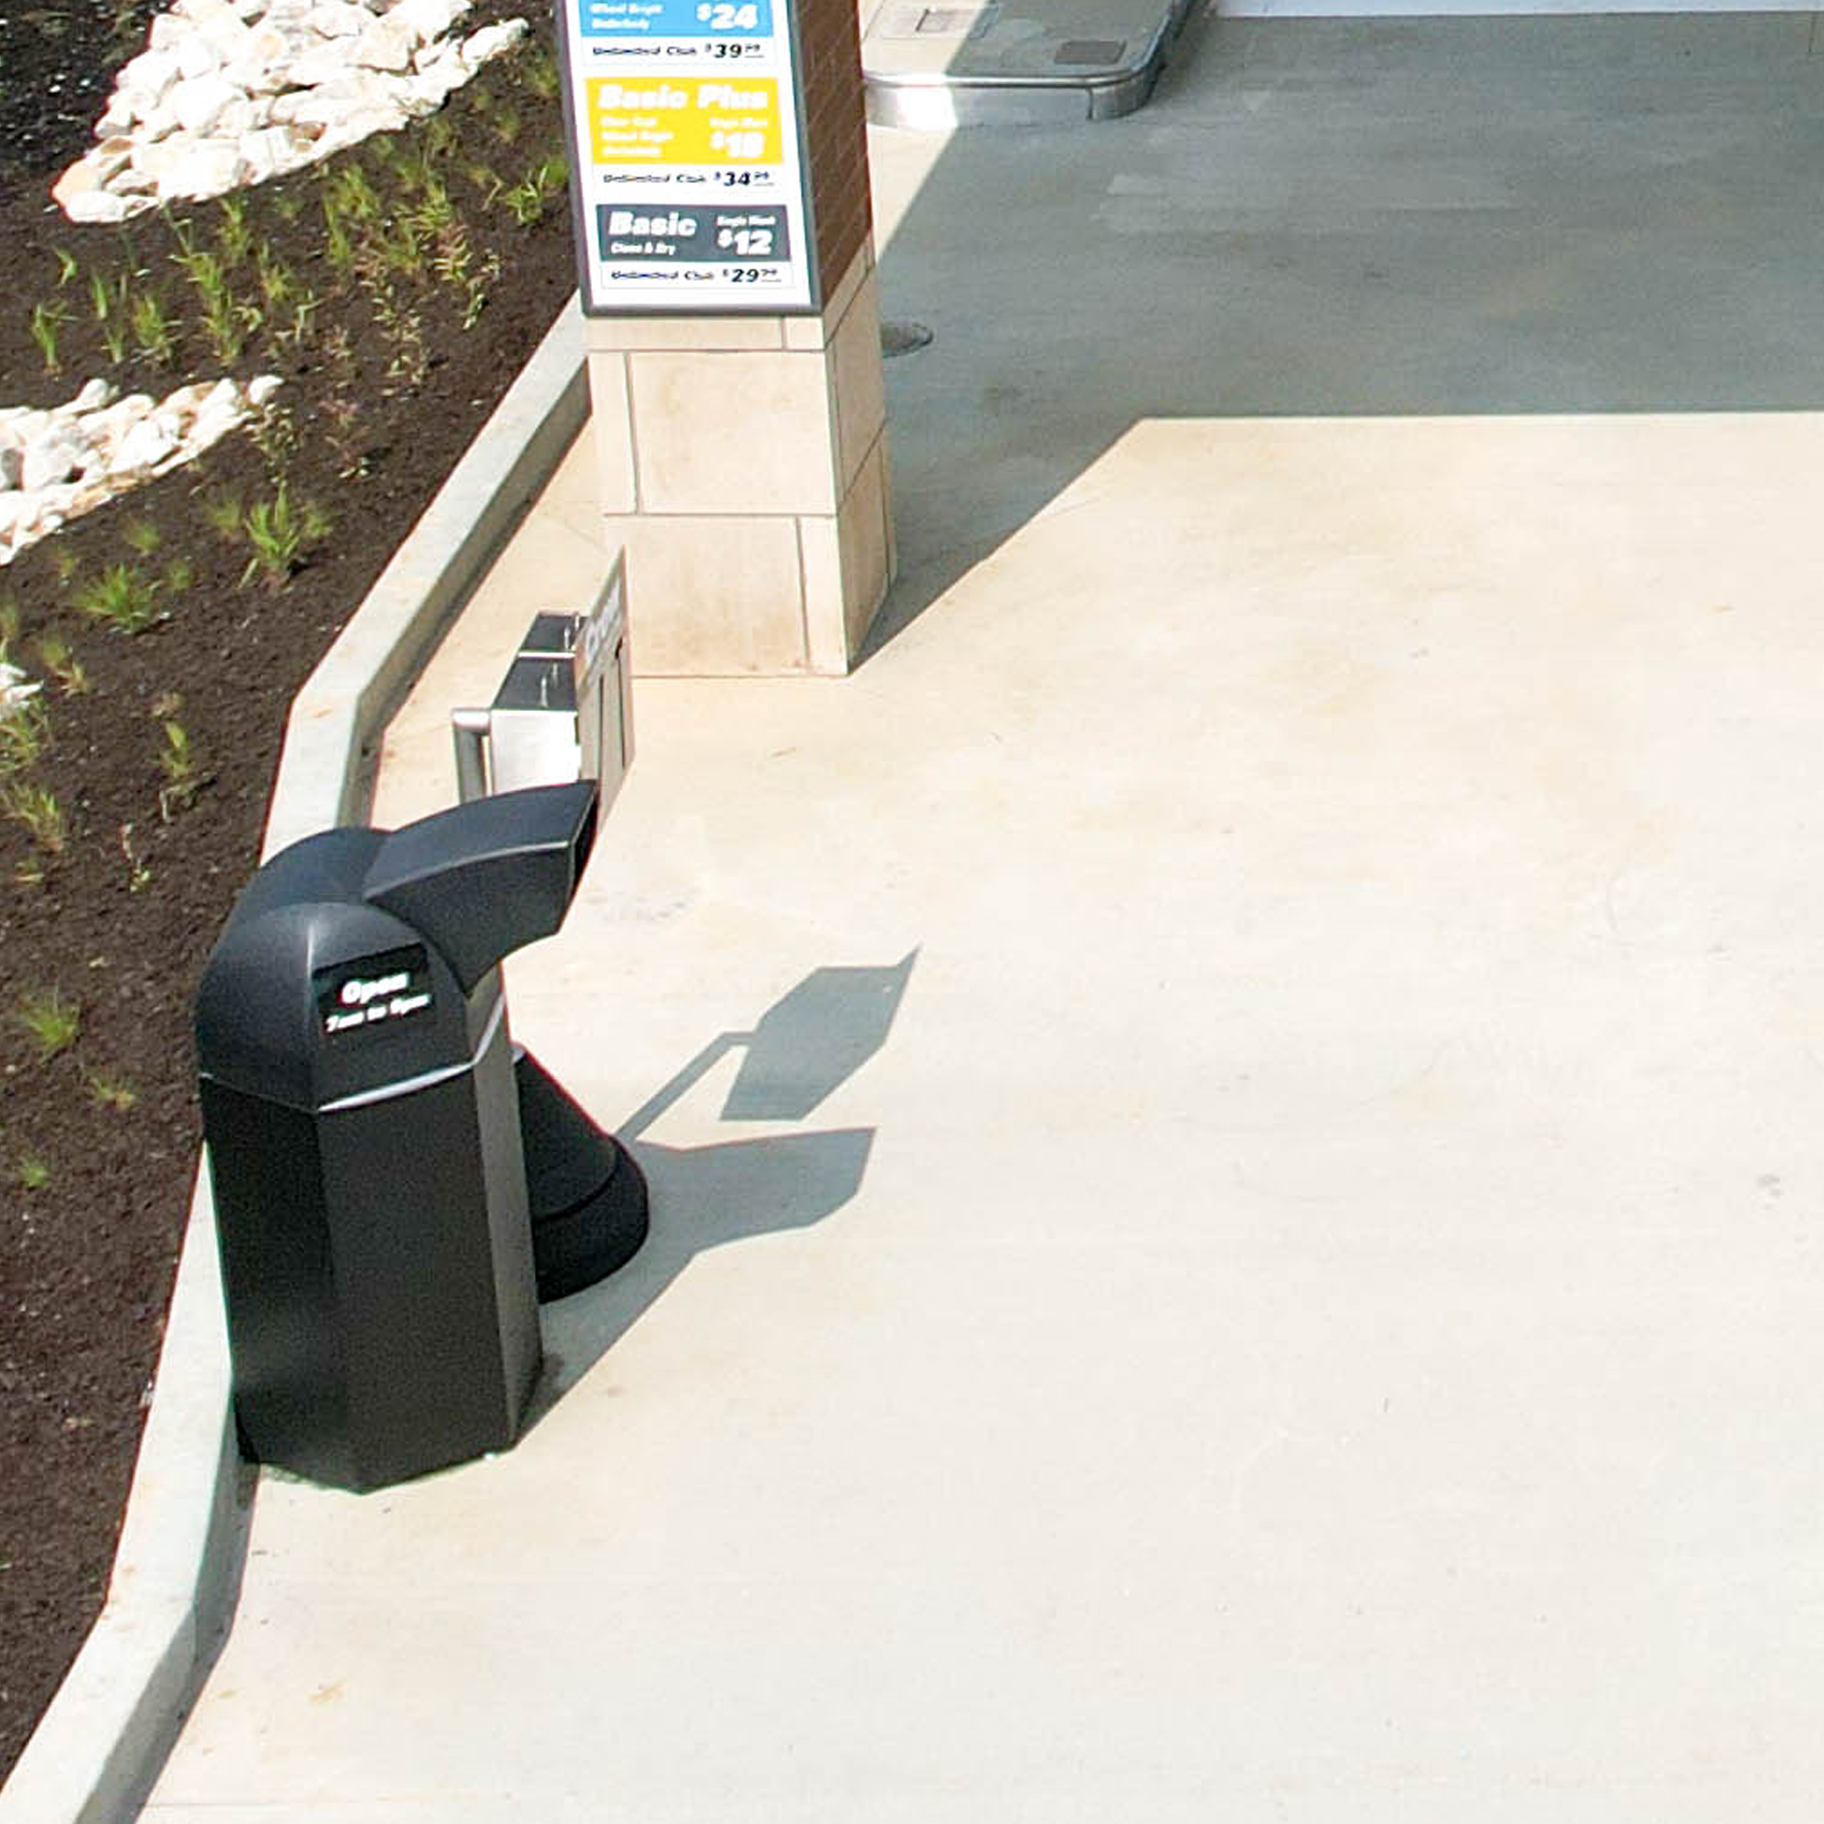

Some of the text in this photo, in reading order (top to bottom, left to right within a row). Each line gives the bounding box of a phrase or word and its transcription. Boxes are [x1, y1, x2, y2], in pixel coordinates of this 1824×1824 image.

[697, 3, 759, 30] $24
[598, 84, 768, 110] Basic Plus
[608, 211, 697, 236] Basic
[718, 229, 773, 255] $12
[341, 972, 410, 1005] Open
